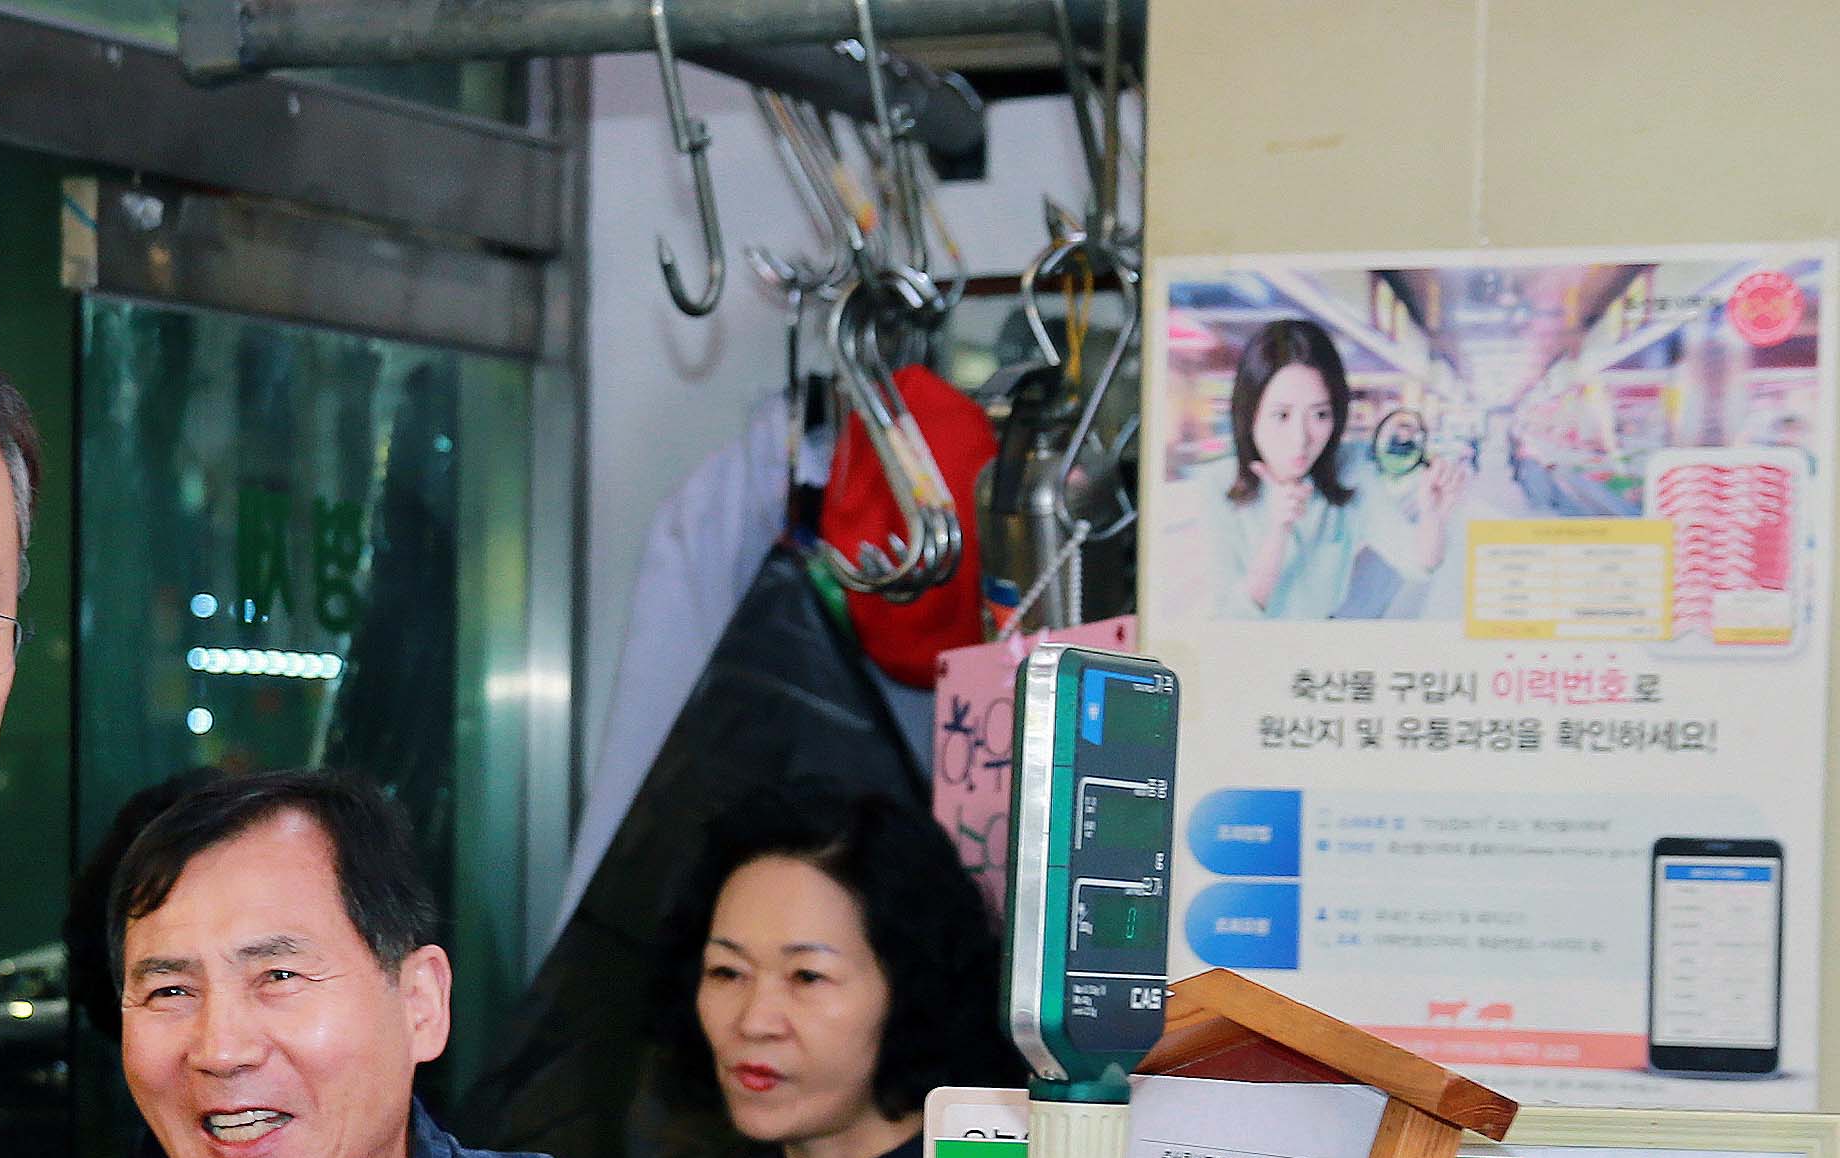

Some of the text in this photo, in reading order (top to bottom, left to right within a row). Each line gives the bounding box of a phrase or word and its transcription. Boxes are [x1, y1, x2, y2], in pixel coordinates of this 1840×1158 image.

[1289, 668, 1664, 706] 축산물 구입시 이력번호로
[1258, 714, 1718, 755] 원산지 및 유통과정을 확인하세요!
[1130, 986, 1163, 1010] CAS
